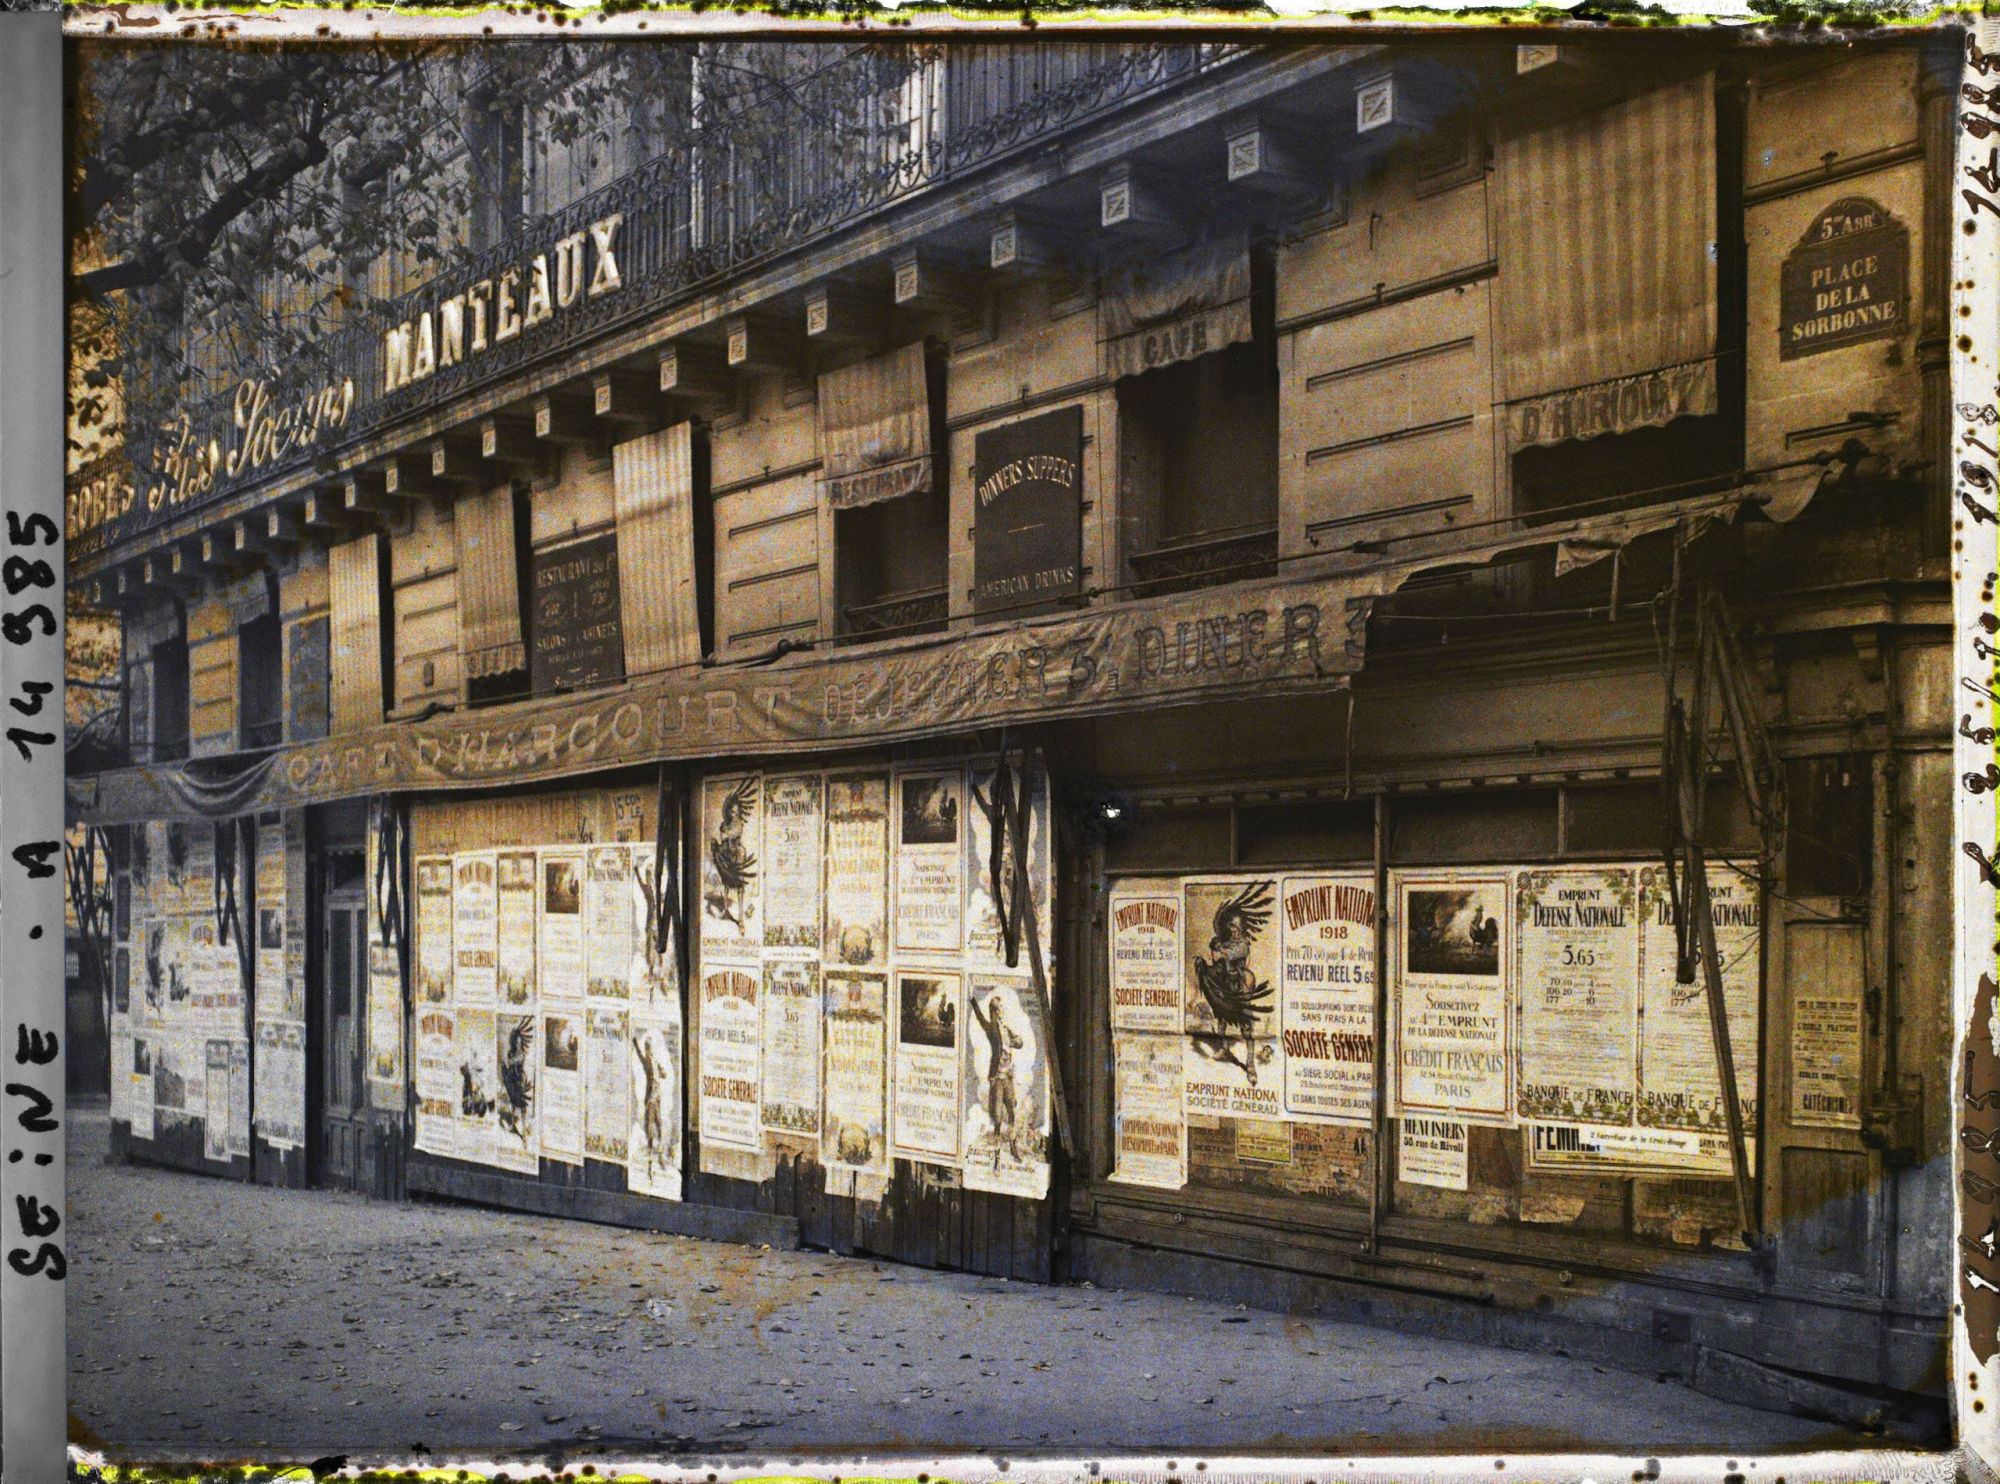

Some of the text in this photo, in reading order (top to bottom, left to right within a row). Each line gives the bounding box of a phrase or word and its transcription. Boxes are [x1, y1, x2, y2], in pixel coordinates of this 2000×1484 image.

[1811, 255, 1878, 289] PLACE
[385, 212, 624, 393] MANTEAUX
[1816, 283, 1871, 312] DE LA
[1792, 300, 1896, 341] SORBONNE
[979, 455, 1076, 507] DINNERS SUPPERS
[536, 557, 591, 589] RESTAURANT
[979, 565, 1075, 599] AMERICAN DRINKS
[12, 841, 61, 879] A
[1558, 889, 1601, 901] EMPRUNT
[1115, 902, 1178, 934] EMPRUNT NATIONAL
[1285, 885, 1332, 932] EMPRUNT
[1574, 901, 1627, 928] NATIONALE
[1137, 925, 1156, 935] 1918
[1320, 925, 1348, 940] 1918
[1116, 948, 1140, 960] REVENU
[1561, 944, 1595, 966] 5.65
[1287, 963, 1324, 983] REVENU
[1115, 985, 1143, 1006] SOCIÉTÉ
[1425, 991, 1480, 1012] Souscrivez
[1545, 987, 1561, 997] 106
[1562, 988, 1573, 997] 20
[1545, 996, 1559, 1005] 177
[1301, 1012, 1321, 1022] SANS
[1324, 1014, 1346, 1024] FRAIS
[1356, 1015, 1367, 1025] LA
[1439, 1015, 1498, 1030] EMPRUNT
[1284, 1027, 1331, 1060] SOCIÉTÉ
[1408, 1027, 1416, 1036] DE
[1418, 1028, 1427, 1036] LA
[1459, 1030, 1498, 1041] NATIONALE
[1447, 1052, 1504, 1076] FRANÇAIS
[1324, 1069, 1349, 1081] SOCIAL
[1187, 1081, 1230, 1099] EMPRUNT
[1301, 1094, 1317, 1104] DANS
[1318, 1095, 1339, 1106] TOUTES
[1340, 1098, 1352, 1107] SES
[1434, 1082, 1472, 1099] PARIS
[1526, 1083, 1570, 1103] BANQUE
[1587, 1088, 1631, 1107] FRANCE
[1648, 1088, 1695, 1109] BANQUE
[1415, 1140, 1464, 1153] rue de Rivoli
